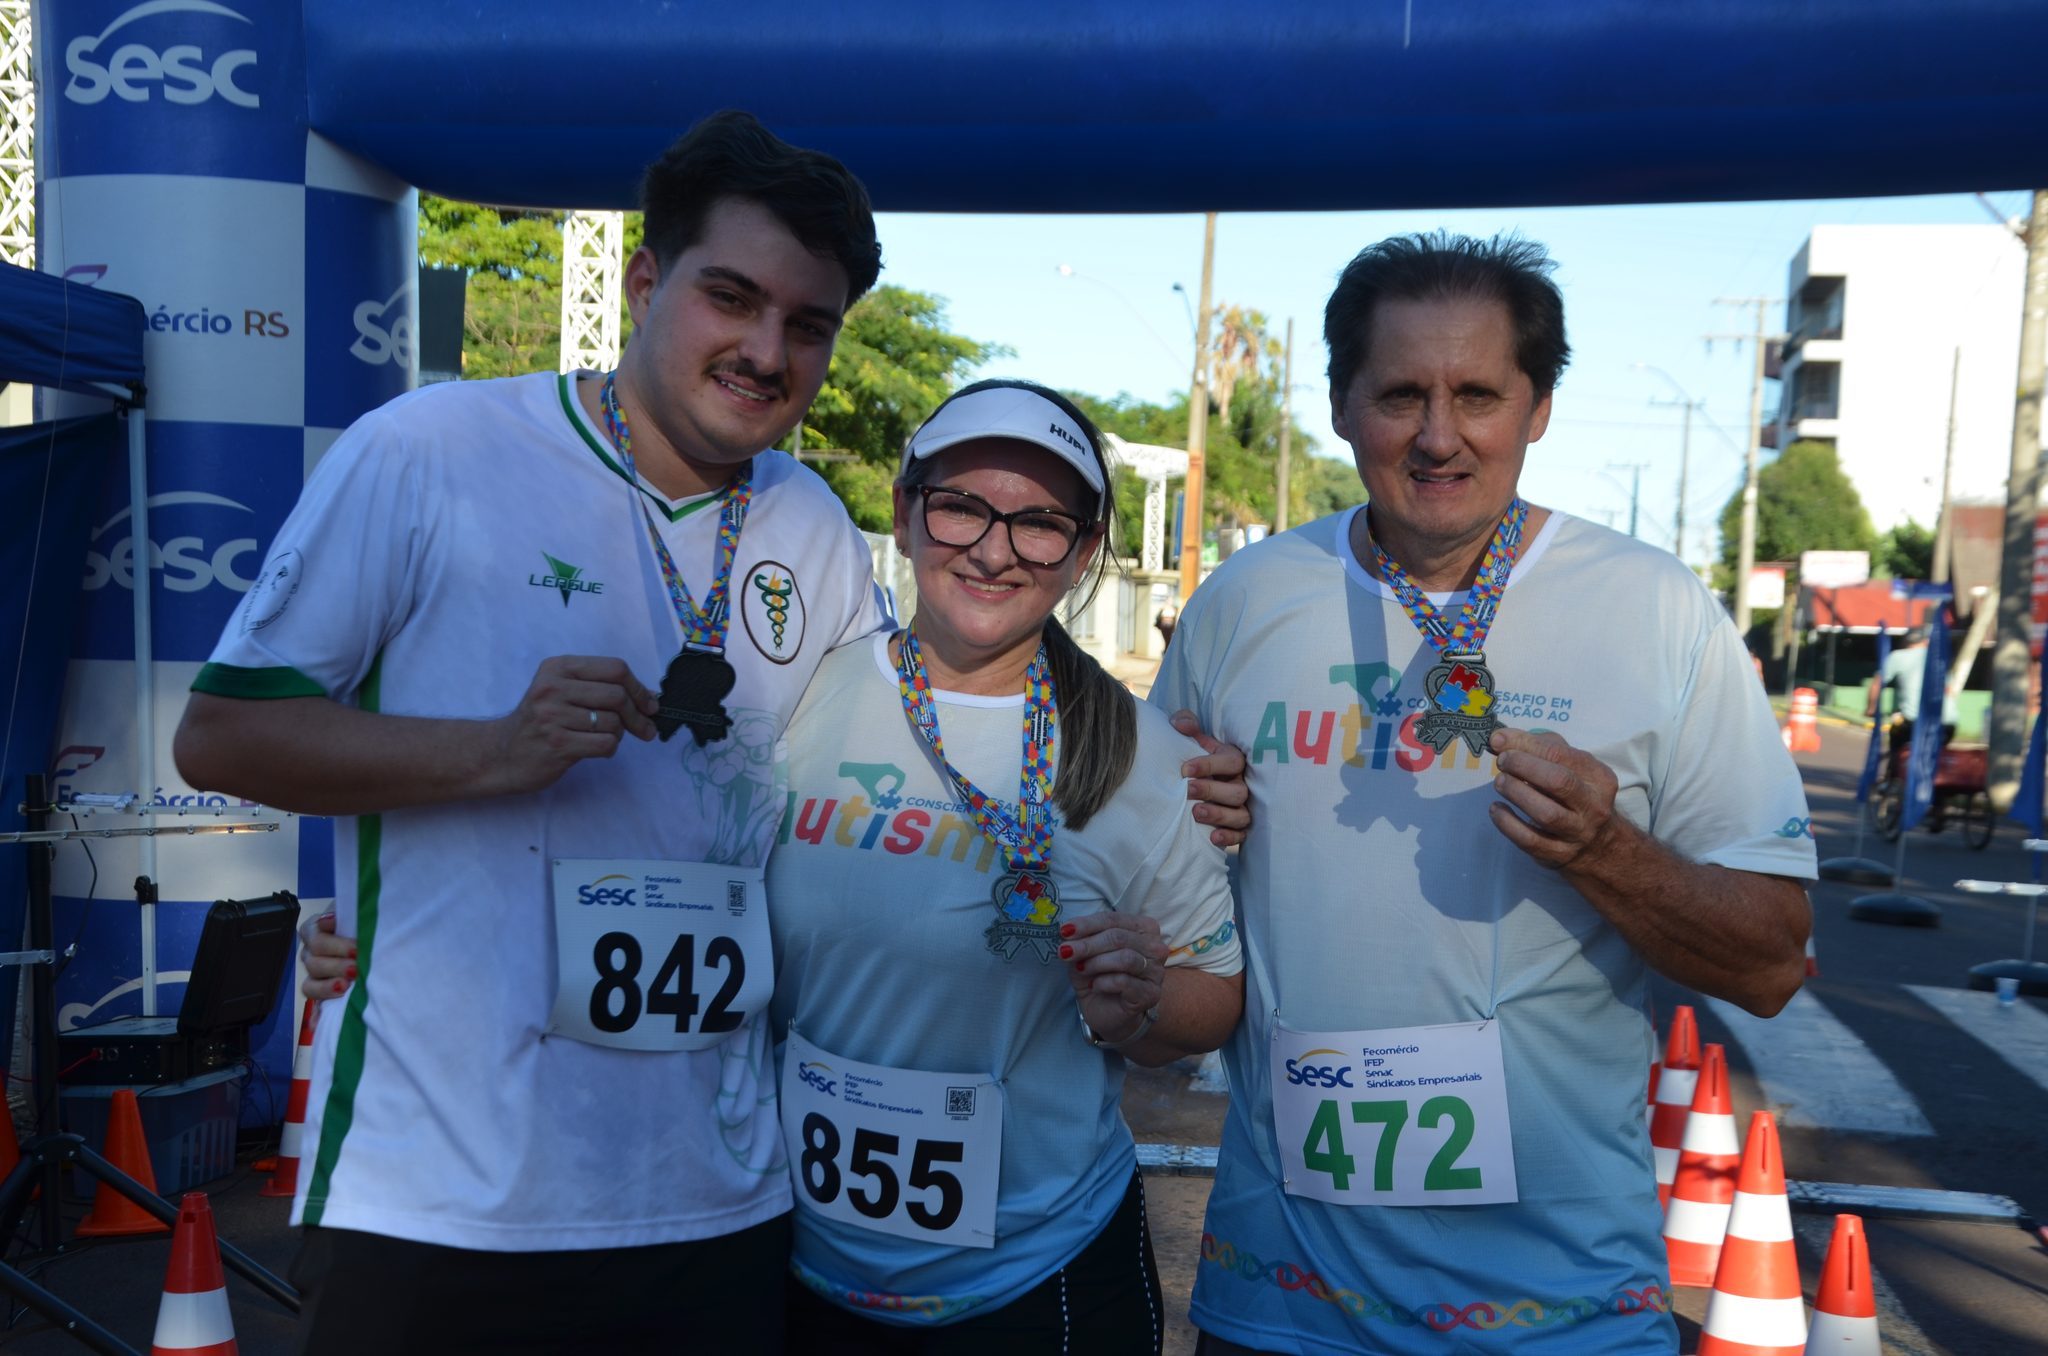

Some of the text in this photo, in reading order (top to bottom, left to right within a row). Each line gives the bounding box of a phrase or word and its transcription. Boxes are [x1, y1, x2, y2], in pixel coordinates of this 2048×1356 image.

[244, 309, 290, 338] RS
[1049, 422, 1086, 456] HUPI
[528, 573, 604, 595] LEAGUE
[1551, 697, 1573, 710] EM
[1547, 710, 1570, 722] AO
[578, 884, 637, 907] Sesc
[589, 931, 746, 1033] 842
[1363, 1045, 1419, 1057] Fecomércio
[1285, 1058, 1354, 1089] Sesc
[1364, 1059, 1384, 1067] IFEP
[1365, 1069, 1394, 1078] Senac
[799, 1062, 838, 1097] Sesc
[1366, 1072, 1483, 1089] Sindicatos Empresariais
[1303, 1096, 1482, 1191] 472
[801, 1112, 964, 1231] 855
